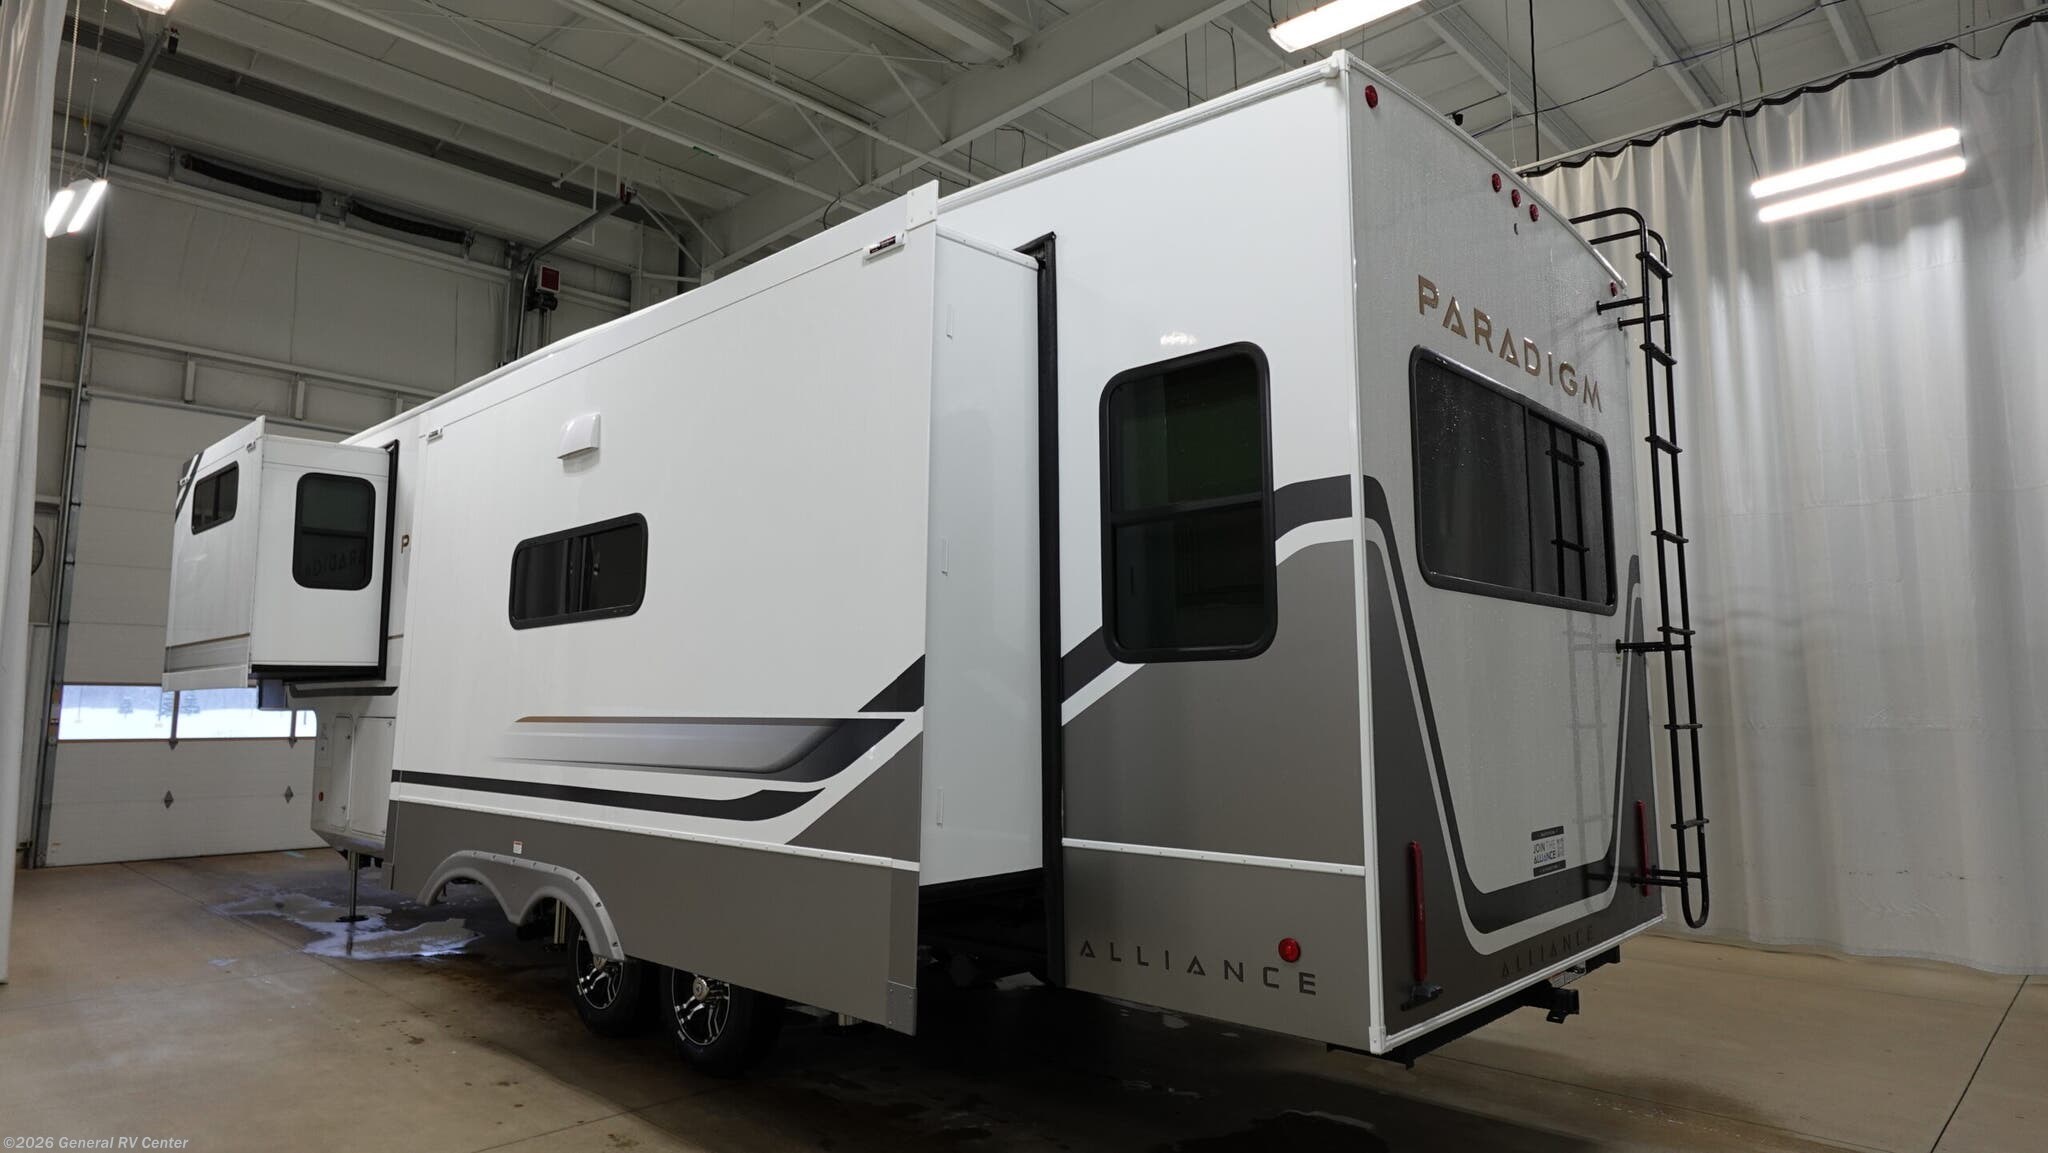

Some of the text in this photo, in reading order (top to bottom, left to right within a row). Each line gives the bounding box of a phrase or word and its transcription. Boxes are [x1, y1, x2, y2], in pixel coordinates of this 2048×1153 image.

[1417, 274, 1602, 413] PARADIGM
[1080, 940, 1317, 996] ALLIANCE
[1502, 924, 1593, 977] ALLIANCE
